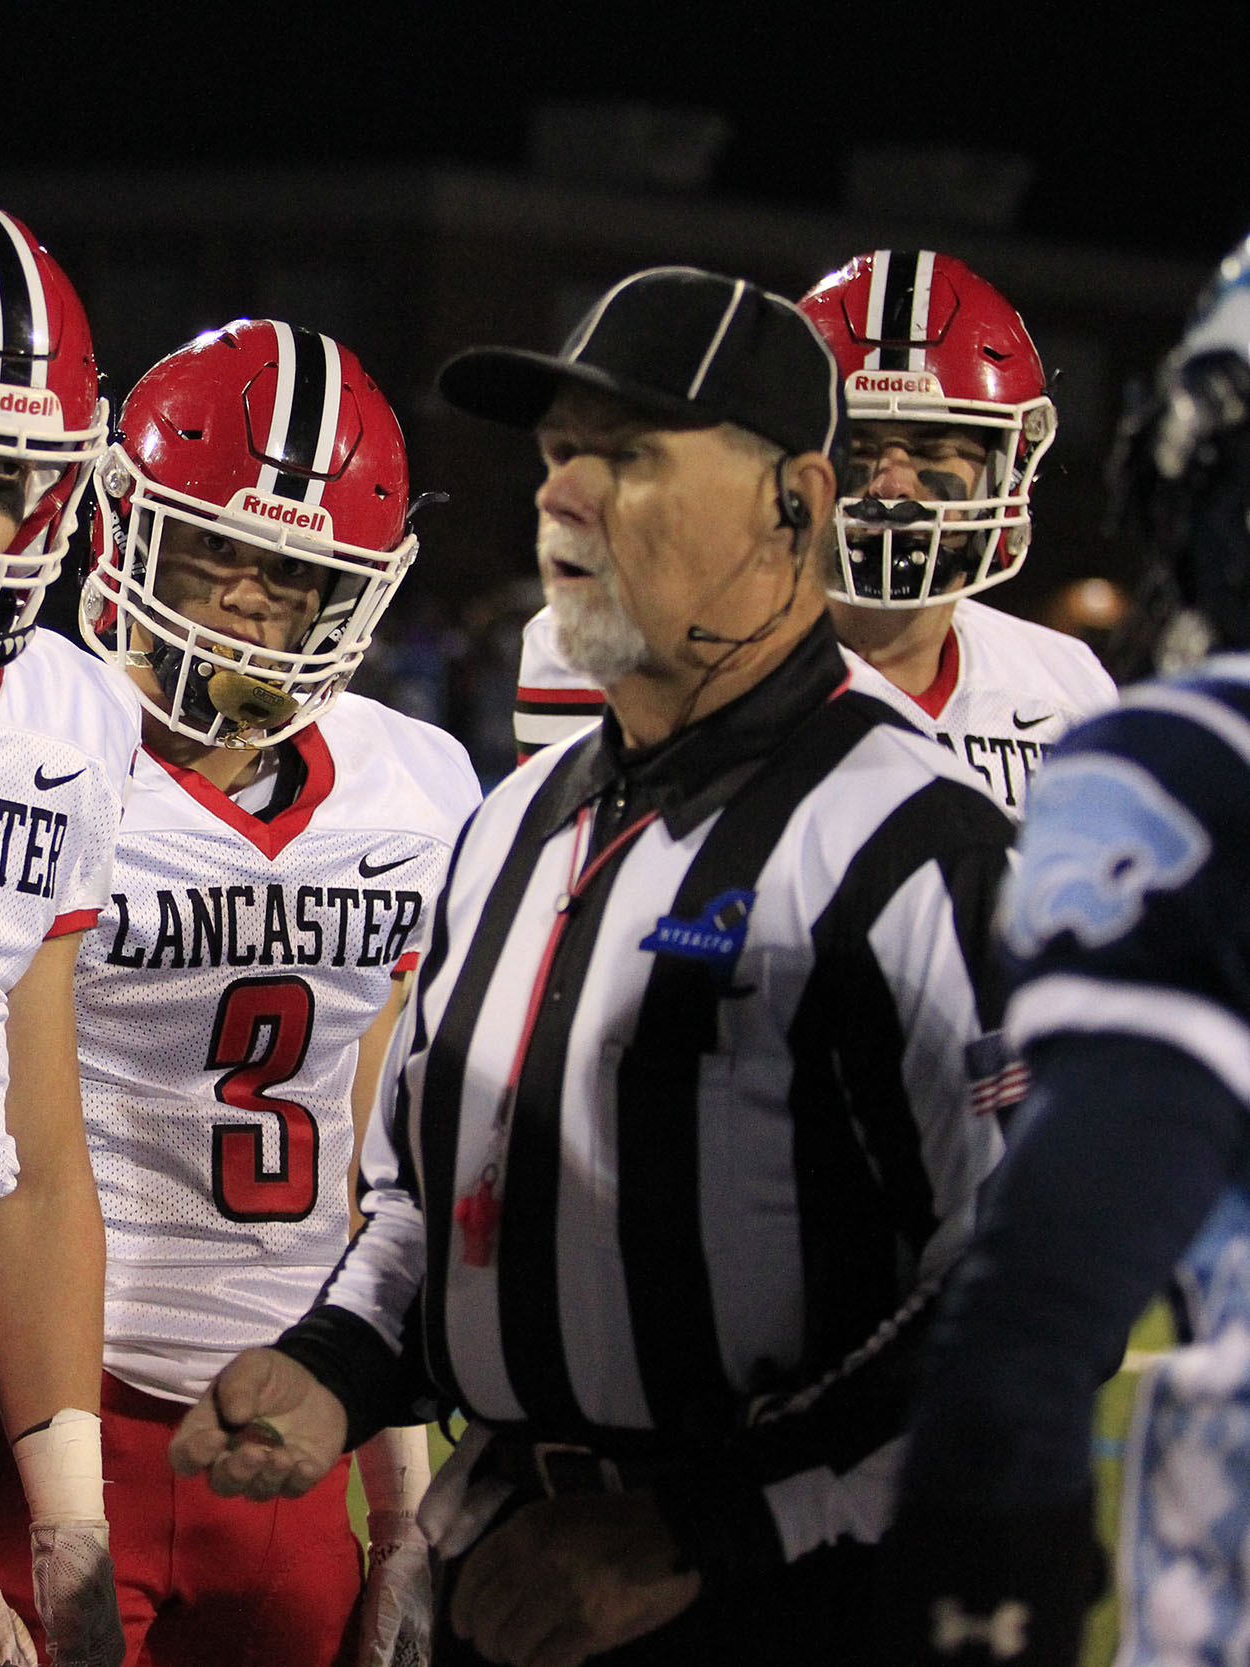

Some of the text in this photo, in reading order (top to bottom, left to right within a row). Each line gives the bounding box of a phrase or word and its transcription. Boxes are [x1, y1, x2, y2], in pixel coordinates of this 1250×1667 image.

[855, 375, 931, 393] Riddell
[243, 495, 326, 532] Riddell
[105, 884, 422, 969] LANCASTER
[203, 974, 320, 1224] 3
